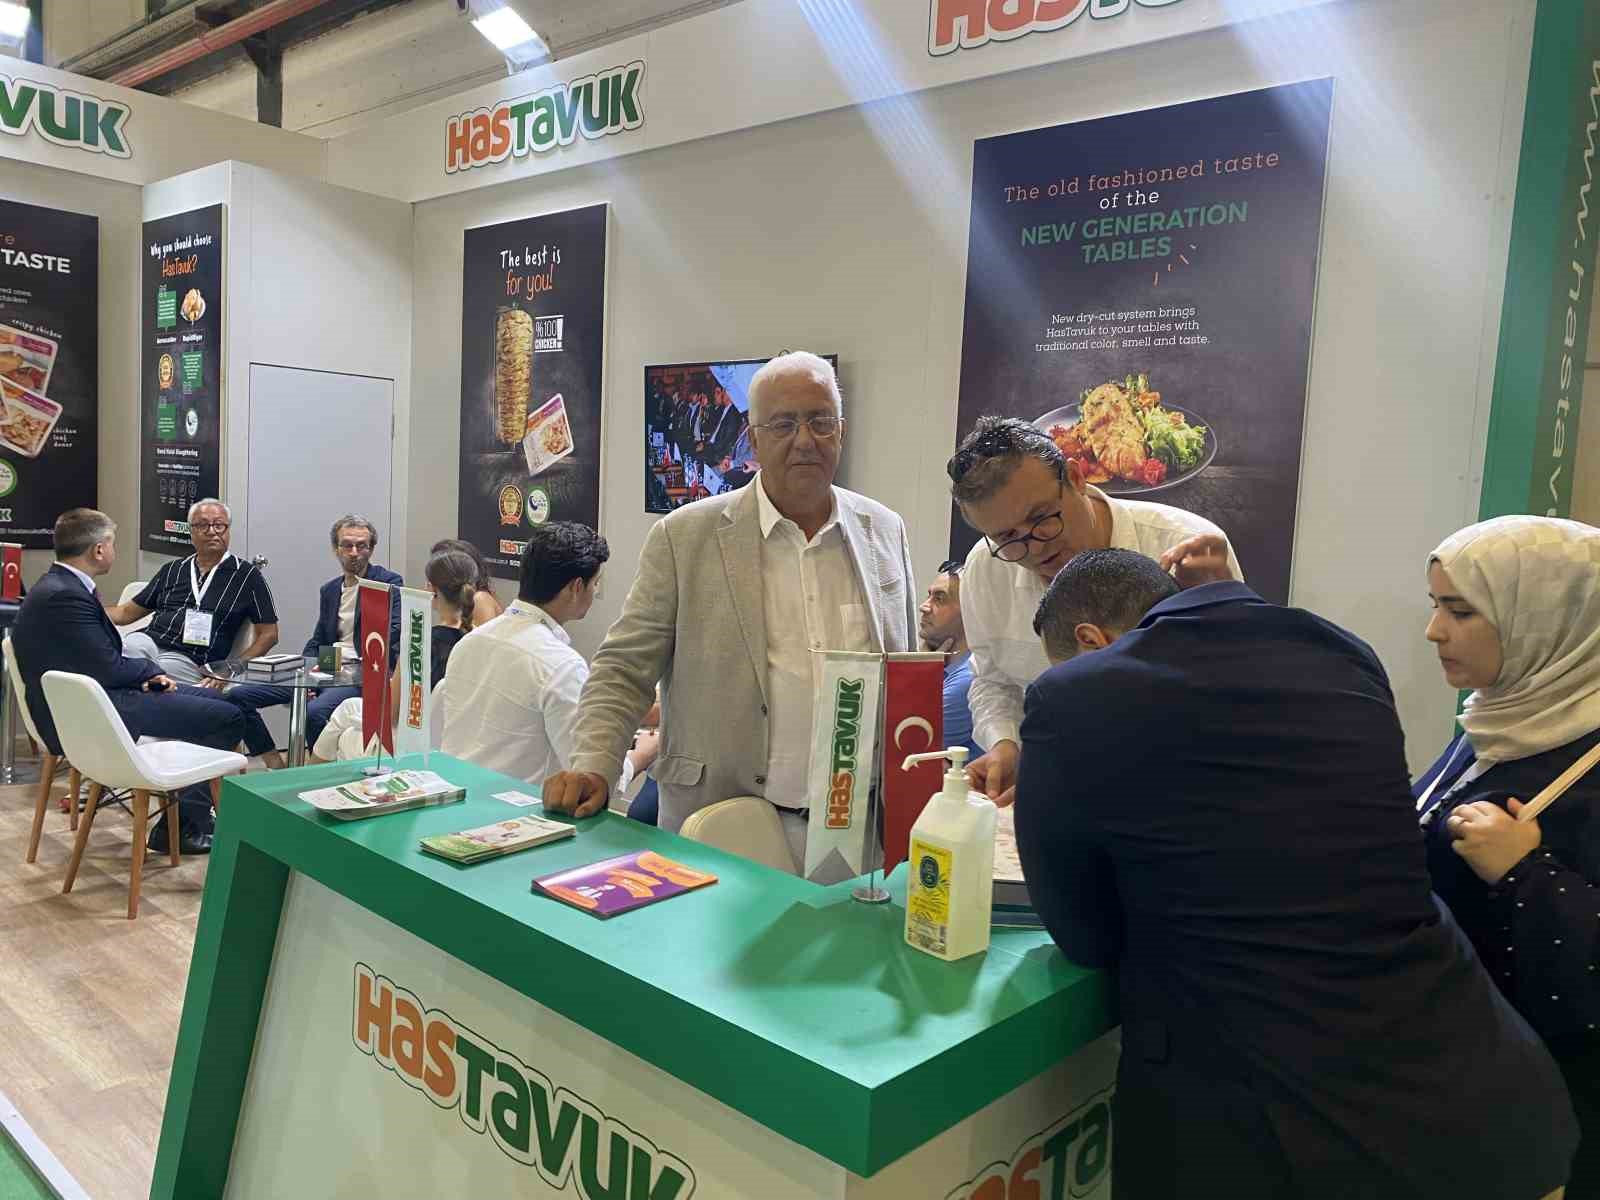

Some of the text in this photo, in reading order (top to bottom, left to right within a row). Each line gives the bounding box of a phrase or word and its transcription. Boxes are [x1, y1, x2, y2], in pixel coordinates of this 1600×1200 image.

[1005, 151, 1280, 203] The old fashioned taste
[1100, 190, 1160, 210] of the
[1021, 201, 1249, 247] NEW GENERATION
[162, 243, 173, 258] you
[174, 235, 192, 252] should
[193, 233, 212, 246] choose
[500, 245, 561, 269] The best is
[1081, 236, 1172, 265] TABLES
[1, 247, 71, 273] TASTE
[506, 264, 554, 301] for you!
[1052, 306, 1196, 325] New dry-cut system brings
[1046, 320, 1200, 338] HasTavuk to your tables with
[1035, 340, 1088, 352] traditional
[1122, 336, 1151, 348] smell
[1153, 335, 1176, 346] and
